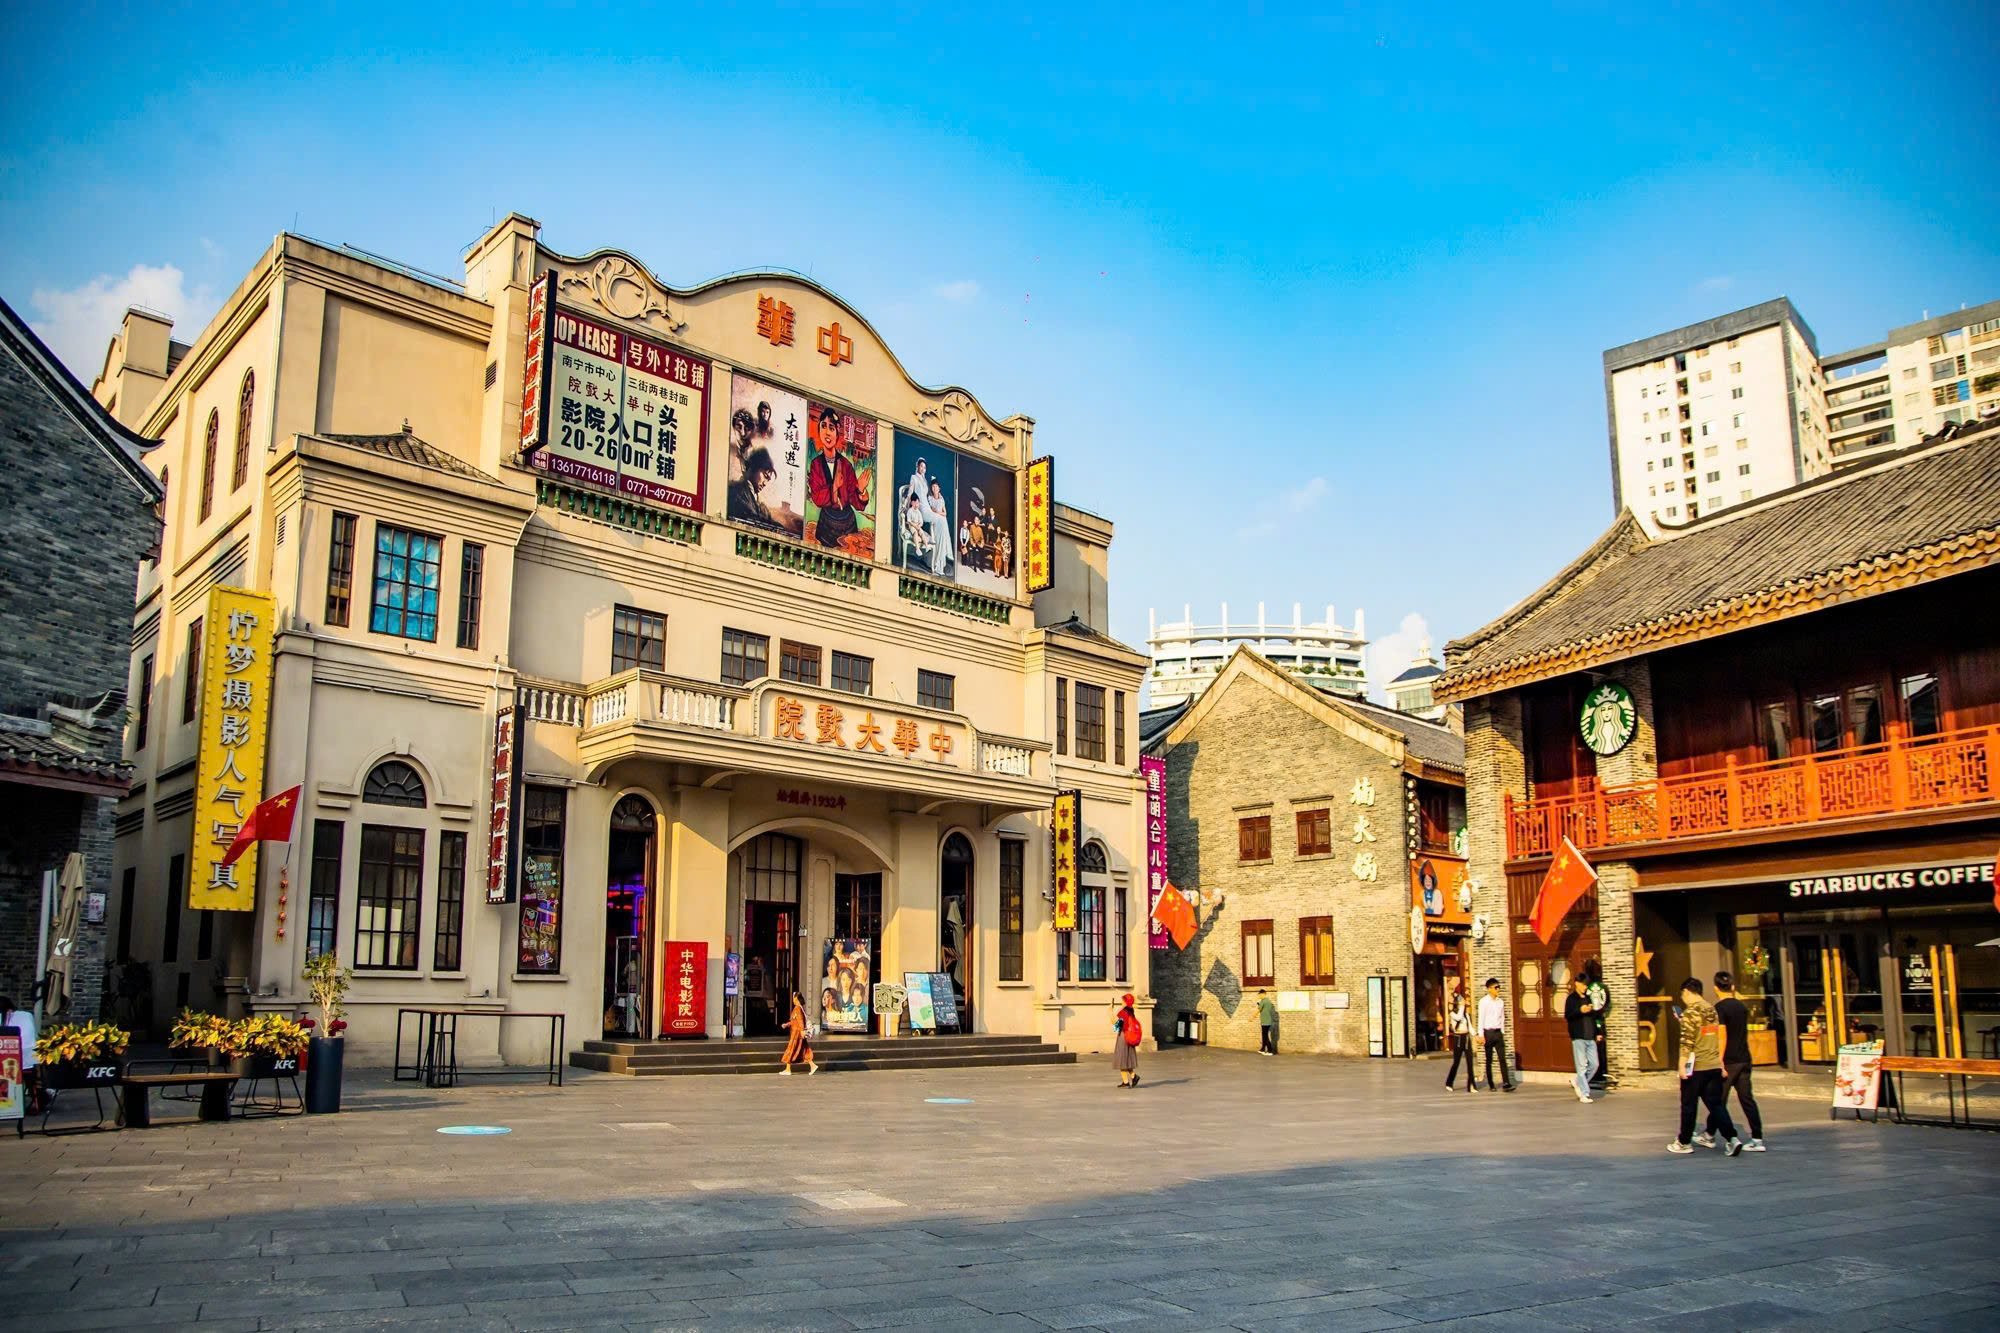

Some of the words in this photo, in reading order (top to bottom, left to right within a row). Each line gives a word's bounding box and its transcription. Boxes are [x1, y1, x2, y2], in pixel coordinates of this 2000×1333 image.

[578, 322, 617, 358] LEASE
[562, 354, 616, 382] 南宁市中心
[628, 376, 688, 407] 三街两巷封面
[561, 396, 652, 448] 影院入口
[656, 404, 678, 481] 头排铺
[551, 458, 616, 487] 13617716118
[626, 479, 693, 508] 0771-4977773
[1789, 871, 1915, 898] STARBUCKS
[678, 949, 694, 1017] 中华电影院
[87, 1066, 116, 1079] KFC
[274, 1059, 296, 1070] KFC
